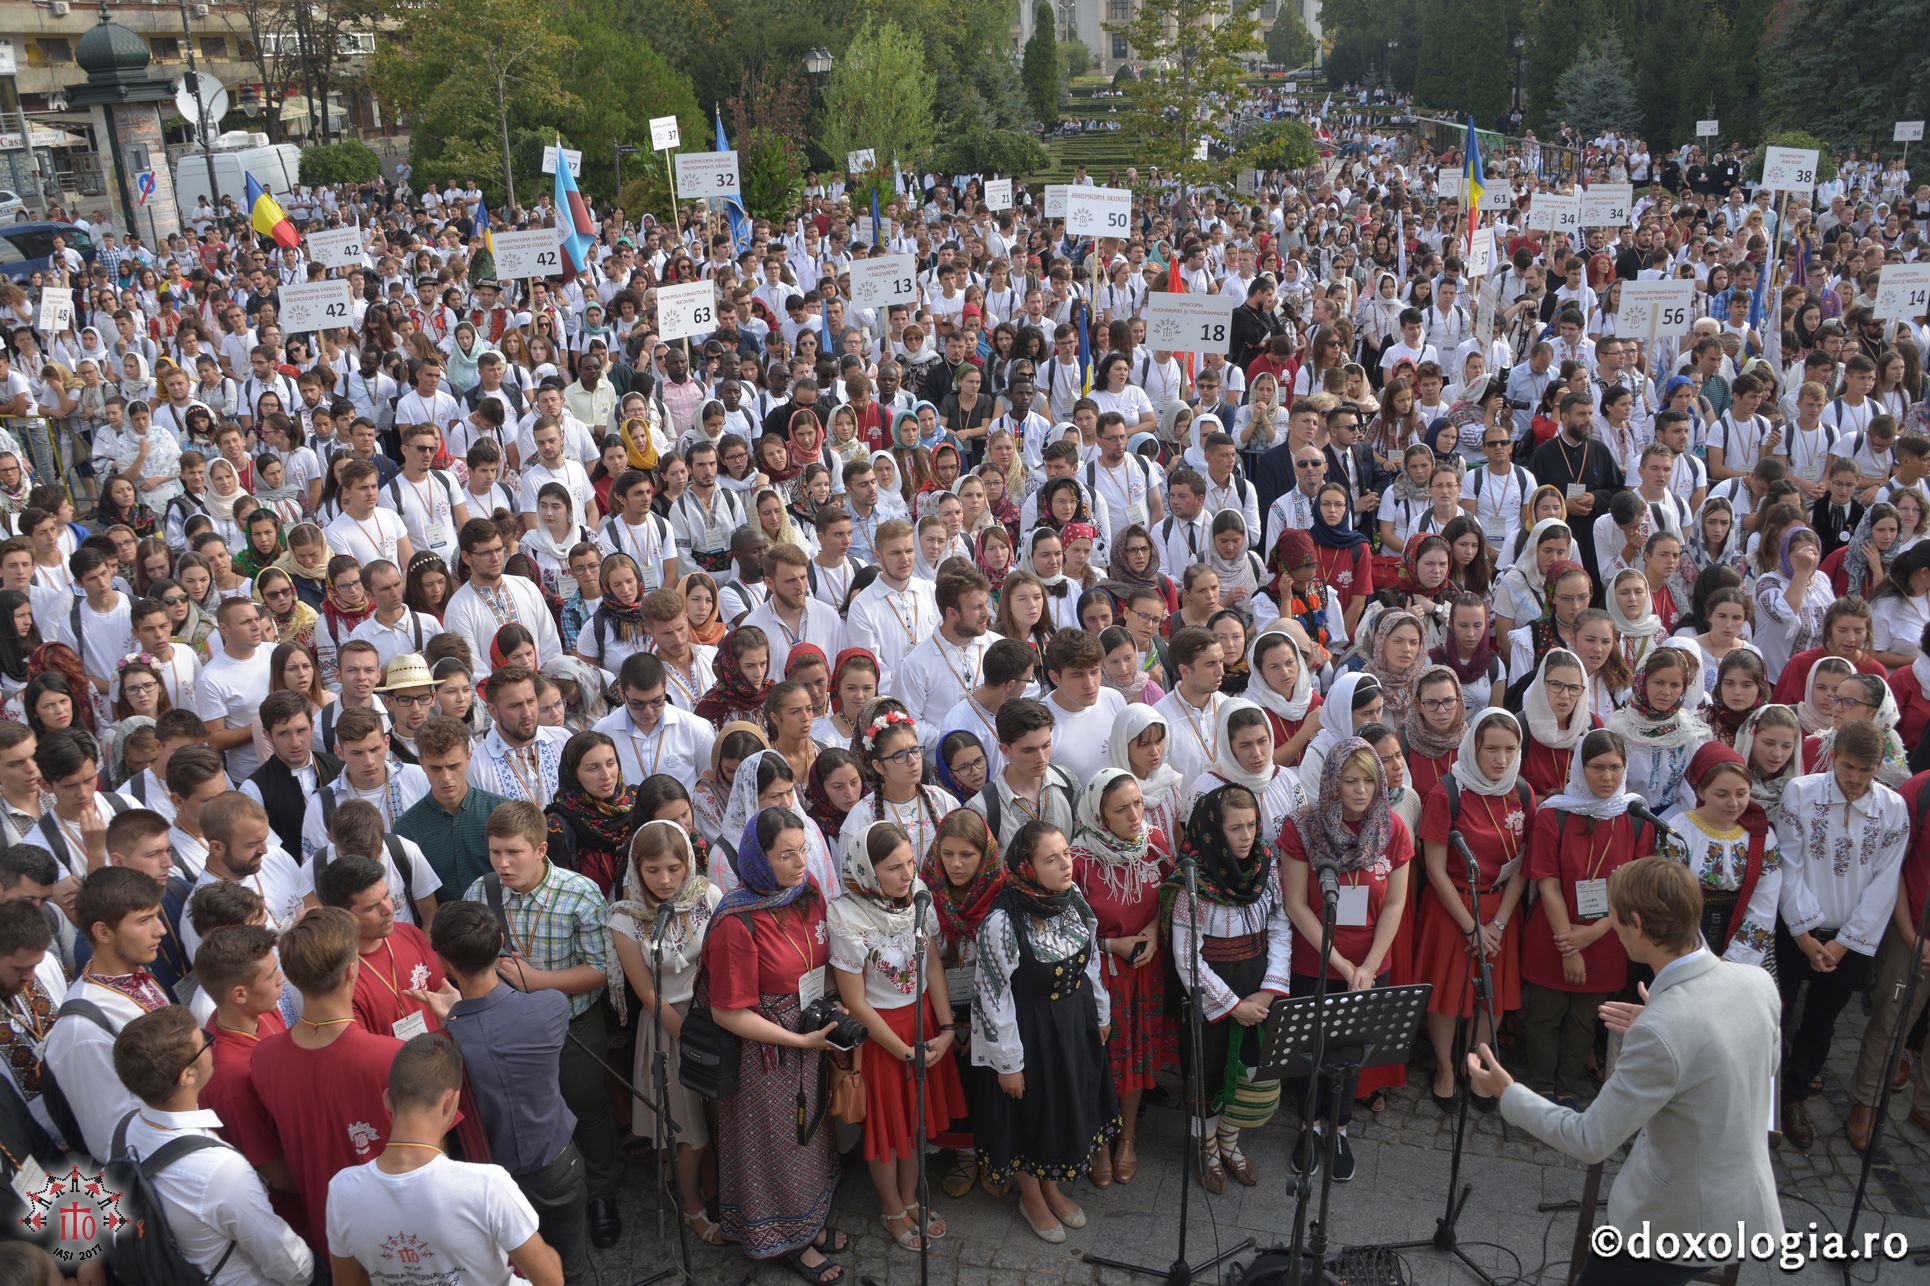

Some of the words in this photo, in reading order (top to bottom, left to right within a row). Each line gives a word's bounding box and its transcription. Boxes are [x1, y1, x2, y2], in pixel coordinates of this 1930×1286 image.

[668, 130, 676, 140] 37
[0, 136, 24, 148] Casa
[716, 173, 735, 187] 32
[1796, 170, 1812, 182] 38
[1002, 194, 1010, 203] 21
[1071, 192, 1105, 201] ARHIEPISCOPIA
[1494, 194, 1507, 204] 61
[1108, 212, 1127, 227] 50
[1560, 213, 1575, 224] 34
[1610, 208, 1624, 219] 34
[344, 245, 360, 256] 42
[537, 252, 557, 266] 42
[284, 288, 319, 296] ARHIEPISCOPIA
[893, 278, 912, 294] 13
[1909, 290, 1925, 306] 14
[58, 309, 68, 321] 48
[326, 303, 347, 317] 42
[694, 307, 711, 324] 63
[1663, 308, 1684, 325] 56
[1201, 324, 1225, 341] 18
